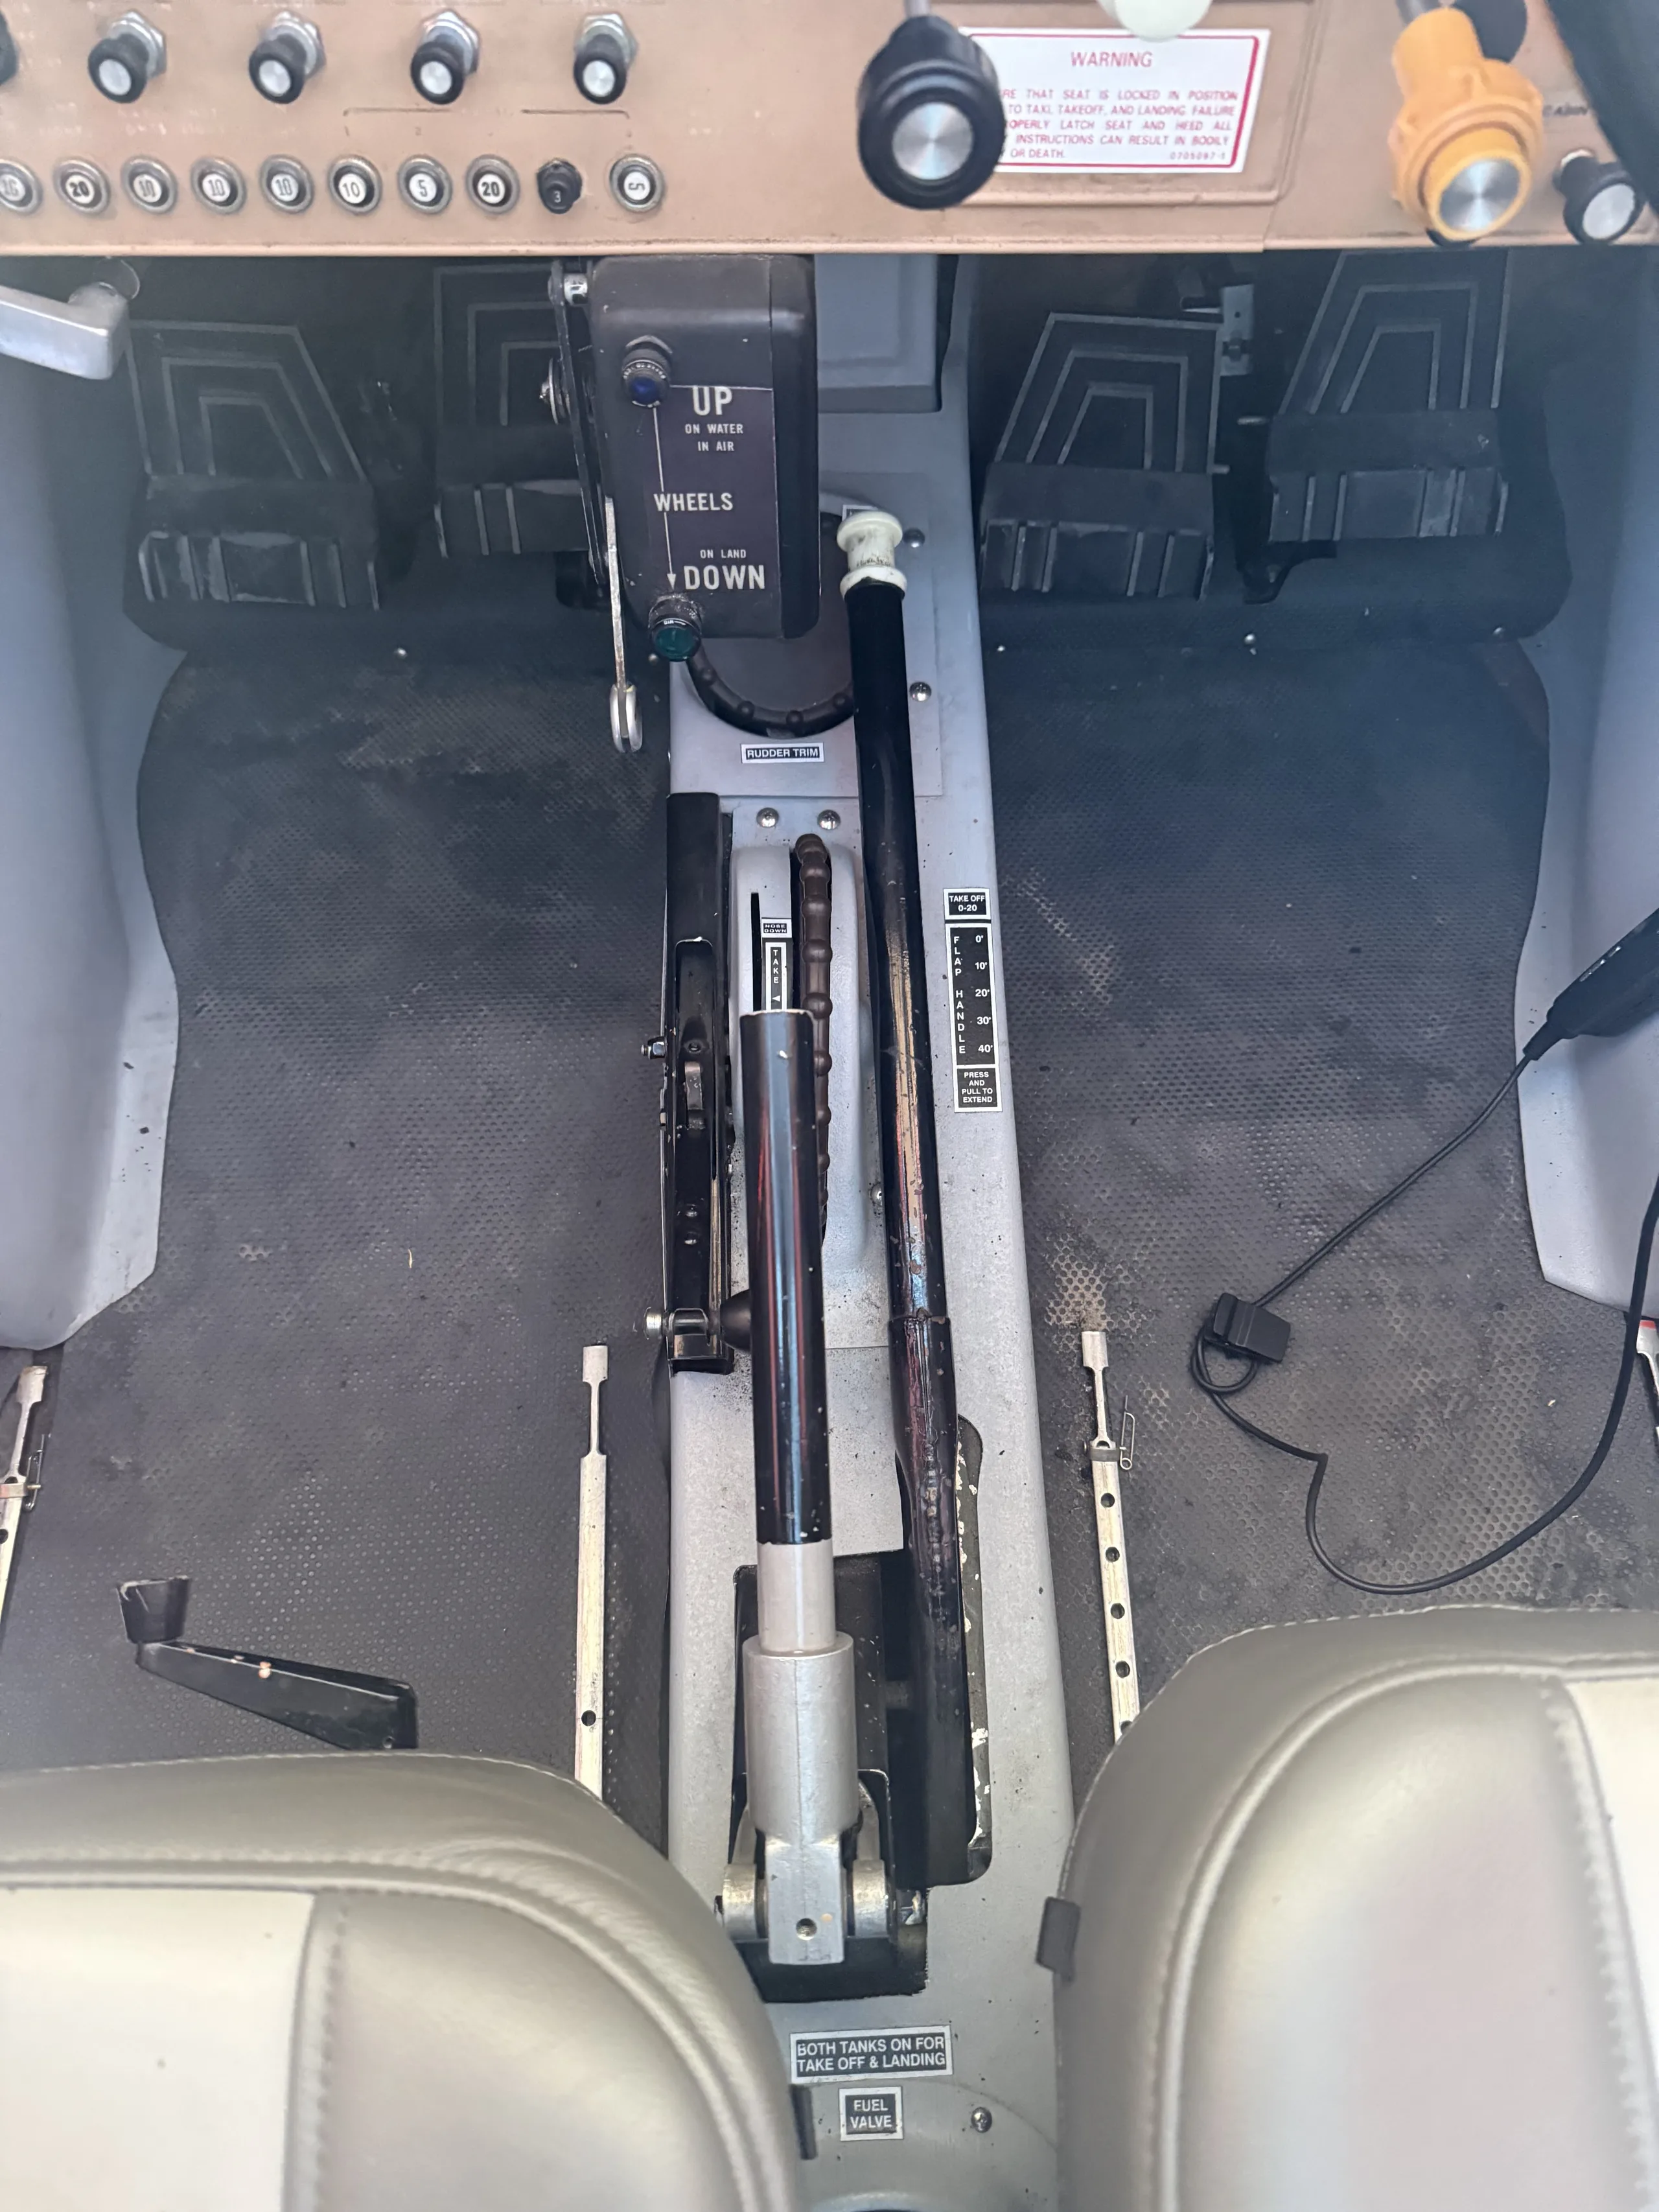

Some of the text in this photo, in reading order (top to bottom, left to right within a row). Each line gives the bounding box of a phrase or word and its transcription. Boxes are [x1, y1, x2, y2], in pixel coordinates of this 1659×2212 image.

[1071, 51, 1153, 67] WARNING
[1027, 89, 1053, 99] THAT
[1063, 89, 1090, 100] SEAT
[1099, 90, 1109, 100] IS
[1118, 90, 1160, 100] LOCKED
[1168, 91, 1179, 100] IN
[1189, 91, 1238, 100] POSITION
[1008, 104, 1021, 114] TO
[1111, 105, 1134, 115] AND
[1138, 106, 1185, 115] LANDING
[1192, 106, 1235, 116] FAILURE
[1006, 120, 1050, 130] OPERLY
[1060, 120, 1095, 130] LATCH
[1106, 121, 1132, 130] SEAT
[1143, 121, 1165, 130] AND
[1213, 121, 1231, 130] ALL
[1015, 134, 1094, 145] INSTRUCTIONS
[1100, 135, 1122, 145] CAN
[1128, 135, 1169, 145] RESULT
[1174, 135, 1185, 145] IN
[1010, 148, 1025, 158] OR
[69, 181, 89, 197] 20
[139, 180, 154, 198] 10
[207, 179, 226, 196] 10
[275, 178, 292, 196] 10
[342, 181, 360, 198] 10
[417, 179, 428, 197] 5
[481, 181, 500, 197] 20
[628, 182, 645, 191] 5
[554, 191, 561, 203] 3
[692, 386, 732, 416] UP
[684, 424, 743, 435] ON WATER
[697, 441, 735, 452] IN AIR
[653, 492, 734, 512] WHEELS
[700, 549, 746, 559] ON LAND
[683, 564, 765, 591] DOWN
[747, 748, 818, 758] RUDDER TRIM
[953, 936, 966, 1054] FLAP HANDLE
[797, 2036, 945, 2056] BOTH TANKS ON FOR
[797, 2052, 946, 2072] TAKE OFF & LANDING
[853, 2099, 888, 2112] FUEL
[850, 2115, 892, 2128] VALVE
